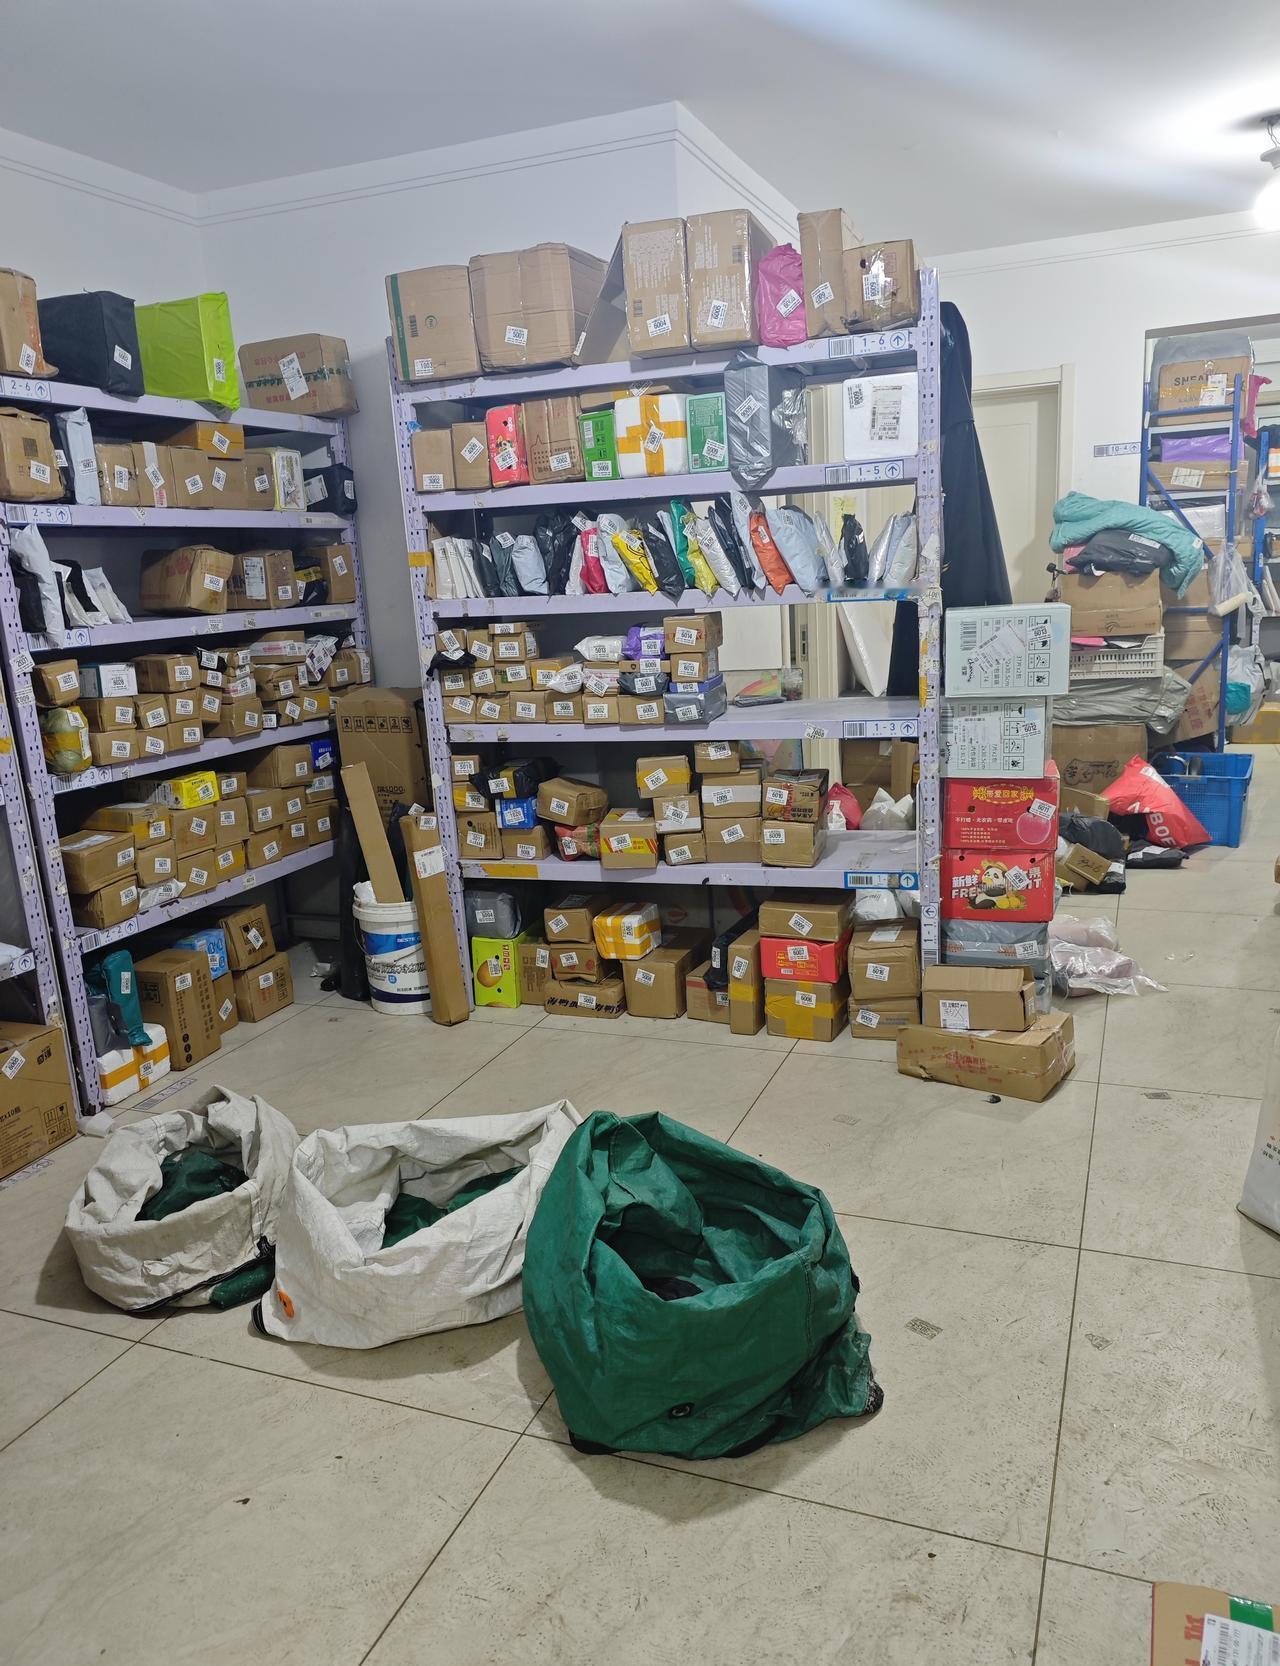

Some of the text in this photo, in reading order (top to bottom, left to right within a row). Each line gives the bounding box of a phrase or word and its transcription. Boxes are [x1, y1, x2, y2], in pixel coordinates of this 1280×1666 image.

[864, 336, 884, 346] 1-6
[11, 380, 31, 391] 2-6
[858, 466, 880, 476] 1-5
[32, 508, 52, 518] 2-5
[874, 723, 895, 732] 1-3
[78, 770, 95, 782] 2-3
[105, 926, 121, 937] 2-2
[923, 923, 934, 943] 1-1
